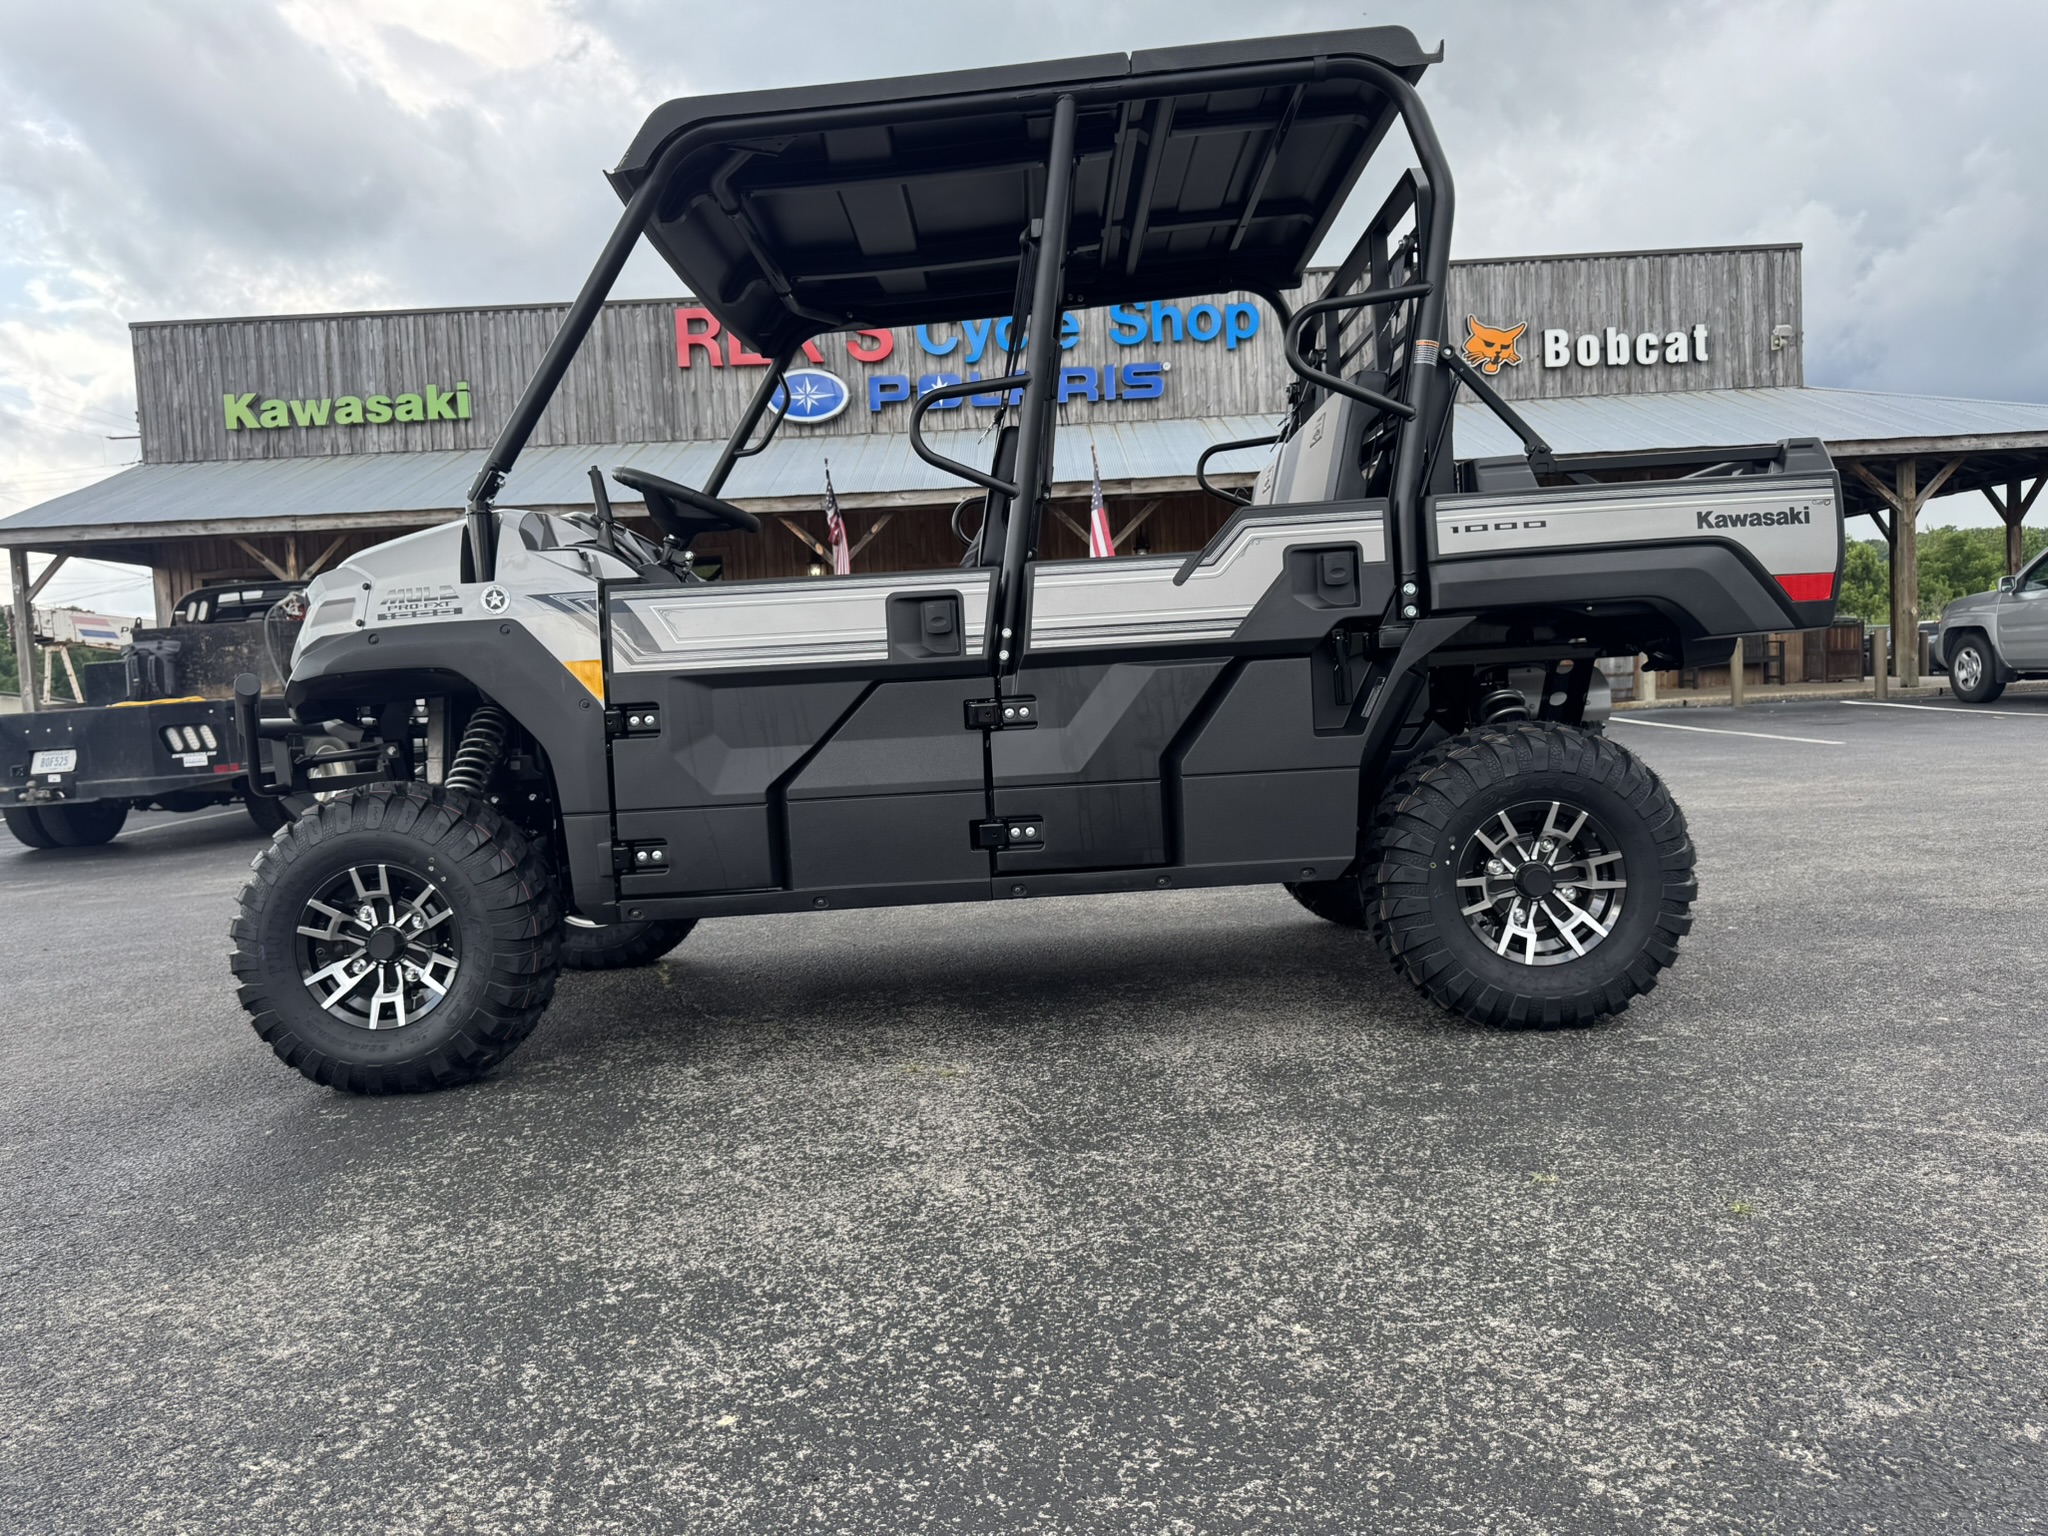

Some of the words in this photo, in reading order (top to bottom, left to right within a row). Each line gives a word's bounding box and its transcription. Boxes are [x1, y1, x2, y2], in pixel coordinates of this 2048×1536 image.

[915, 312, 1080, 363] Cyce
[1109, 300, 1260, 350] Shop
[1544, 323, 1709, 368] Bobcat
[223, 381, 472, 430] Kawasaki
[1450, 520, 1547, 534] 1000
[1696, 506, 1811, 530] Kawasaki
[380, 585, 460, 605] MULE
